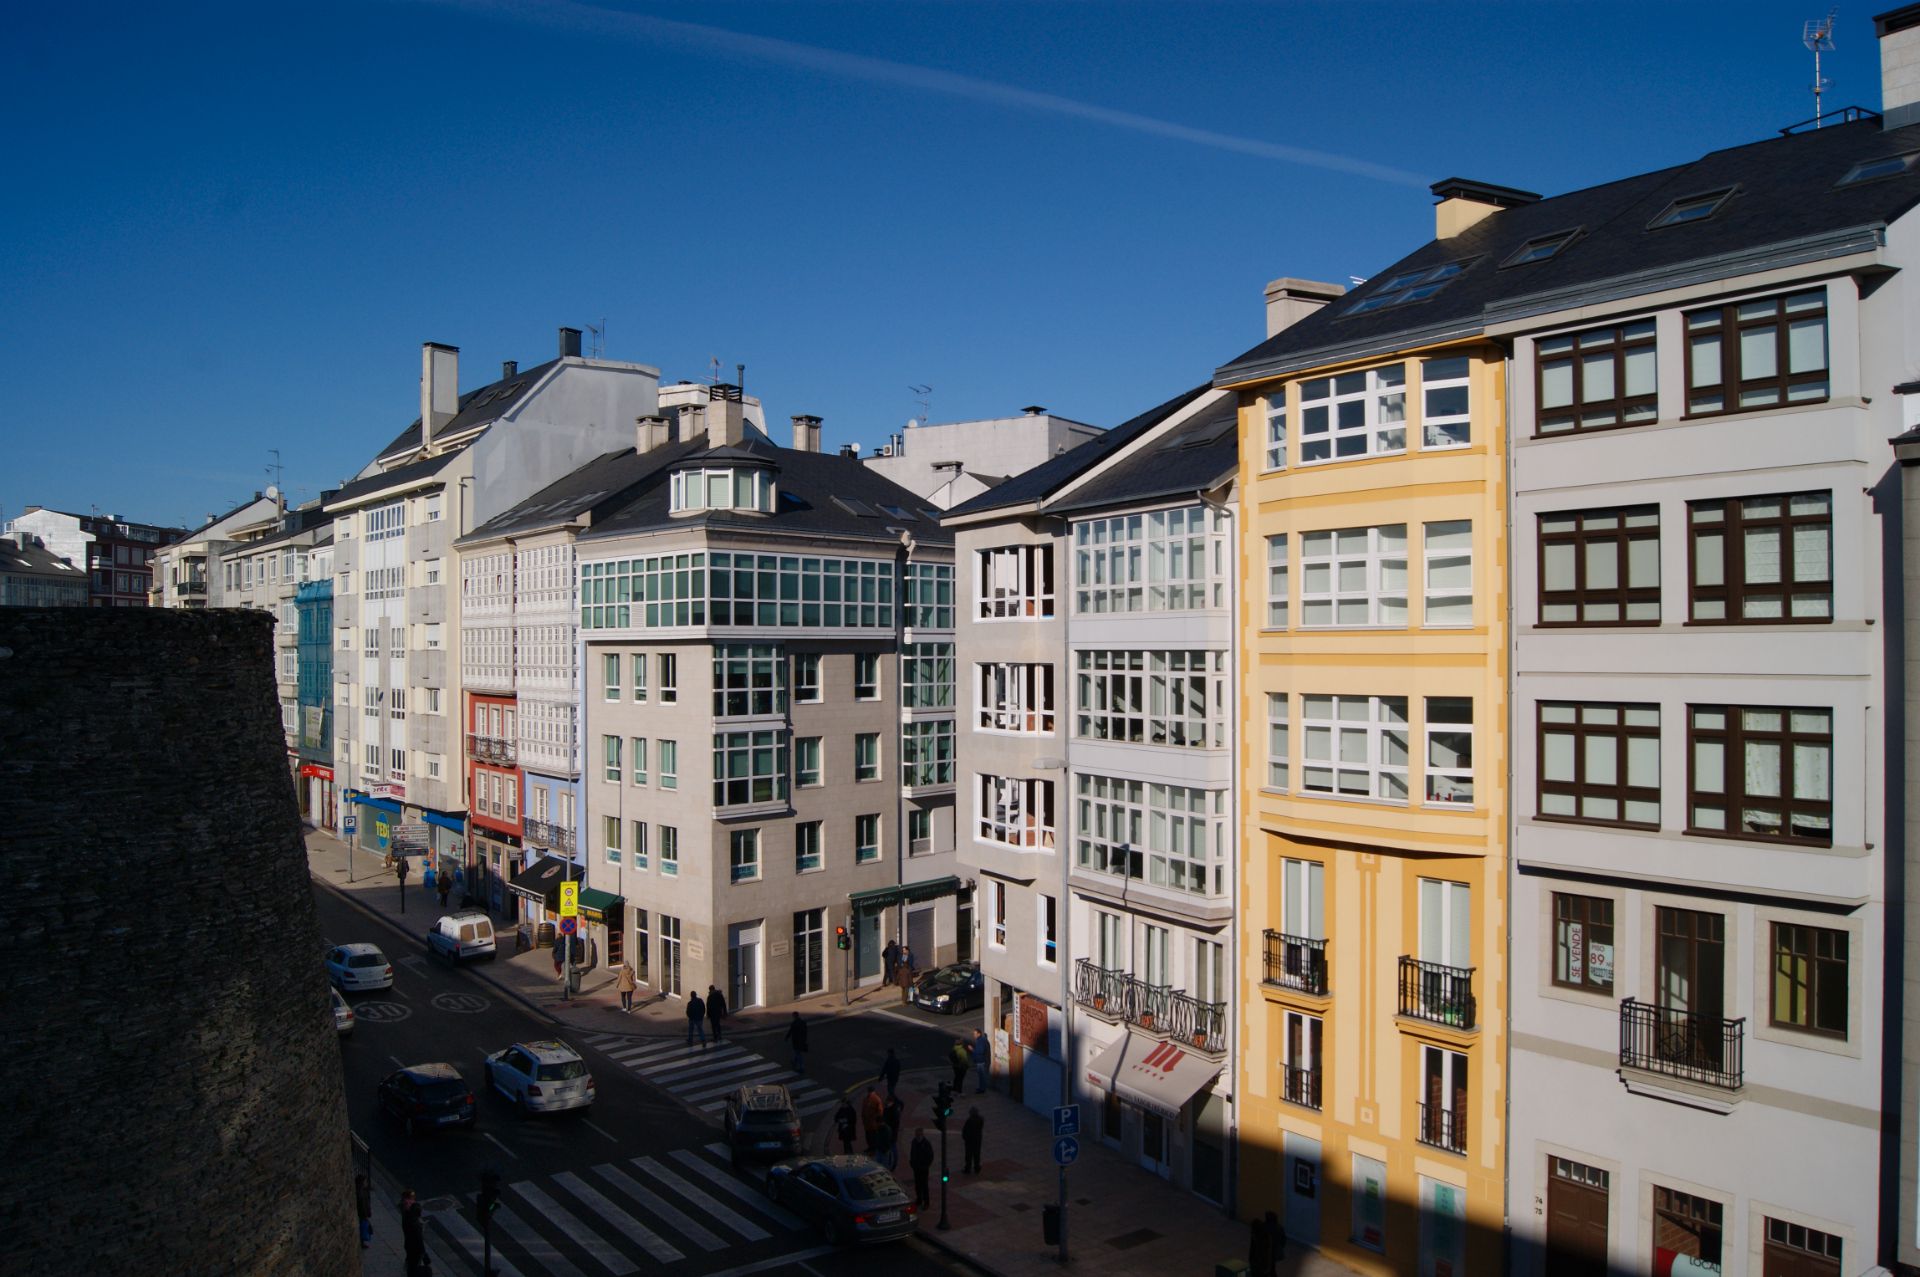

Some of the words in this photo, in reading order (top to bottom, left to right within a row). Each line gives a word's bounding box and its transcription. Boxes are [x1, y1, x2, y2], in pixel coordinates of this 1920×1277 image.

[347, 819, 353, 827] P
[1571, 928, 1582, 962] VENDE
[1590, 953, 1605, 965] 89
[1571, 967, 1581, 978] SE
[439, 996, 483, 1010] 30
[359, 1004, 402, 1019] 30
[1061, 1108, 1072, 1123] P
